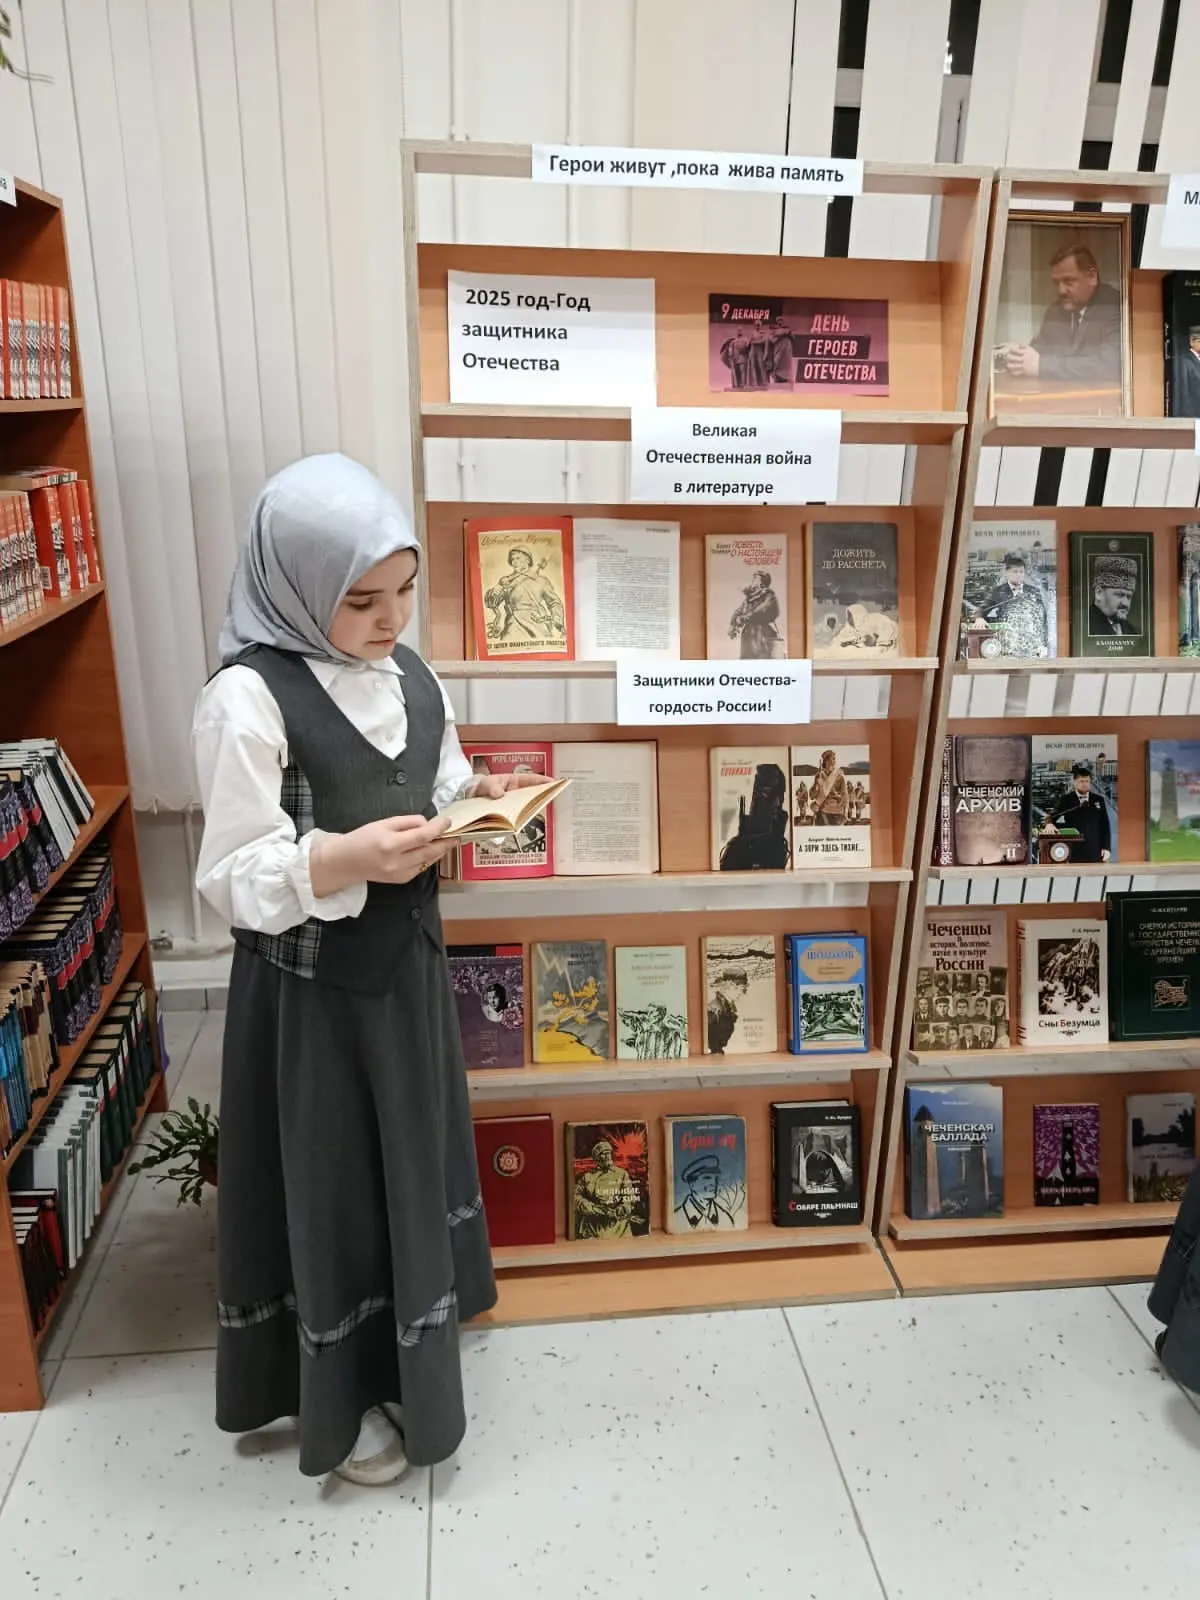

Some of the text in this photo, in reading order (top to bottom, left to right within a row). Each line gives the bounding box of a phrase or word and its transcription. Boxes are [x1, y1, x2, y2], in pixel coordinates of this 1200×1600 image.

[549, 155, 605, 176] Герои
[610, 159, 667, 179] живут
[728, 163, 776, 180] жива
[780, 164, 845, 184] память
[1183, 190, 1200, 205] М
[465, 288, 592, 312] 2025 год-Год
[721, 304, 771, 323] 9 ДЕКАБРЯ
[810, 312, 851, 334] ДЕНЬ
[461, 322, 569, 341] защитника
[807, 338, 858, 358] ГЕРОЕВ
[462, 351, 561, 371] Отечества
[803, 362, 878, 383] ОТЕЧЕСТВА
[692, 422, 758, 438] Великая
[646, 449, 813, 467] Отечественная война
[673, 479, 774, 497] в литературе
[832, 549, 877, 559] ДОЖИТЬ
[822, 560, 887, 570] ДО РАССВЕТА
[633, 673, 797, 688] Защитники Отечества-
[649, 699, 773, 716] гордость России!
[957, 784, 1025, 798] ЧЕЧЕНСКИЙ
[955, 799, 1022, 813] АРХИВ
[804, 843, 820, 853] ЗОРИ
[821, 843, 839, 853] ЗДЕСЬ
[927, 923, 992, 938] Чеченцы
[935, 957, 985, 972] России
[1038, 1018, 1101, 1030] Сны Безумца
[924, 1123, 994, 1134] ЧЕЧЕНСКАЯ
[931, 1132, 988, 1143] БАЛЛАДА
